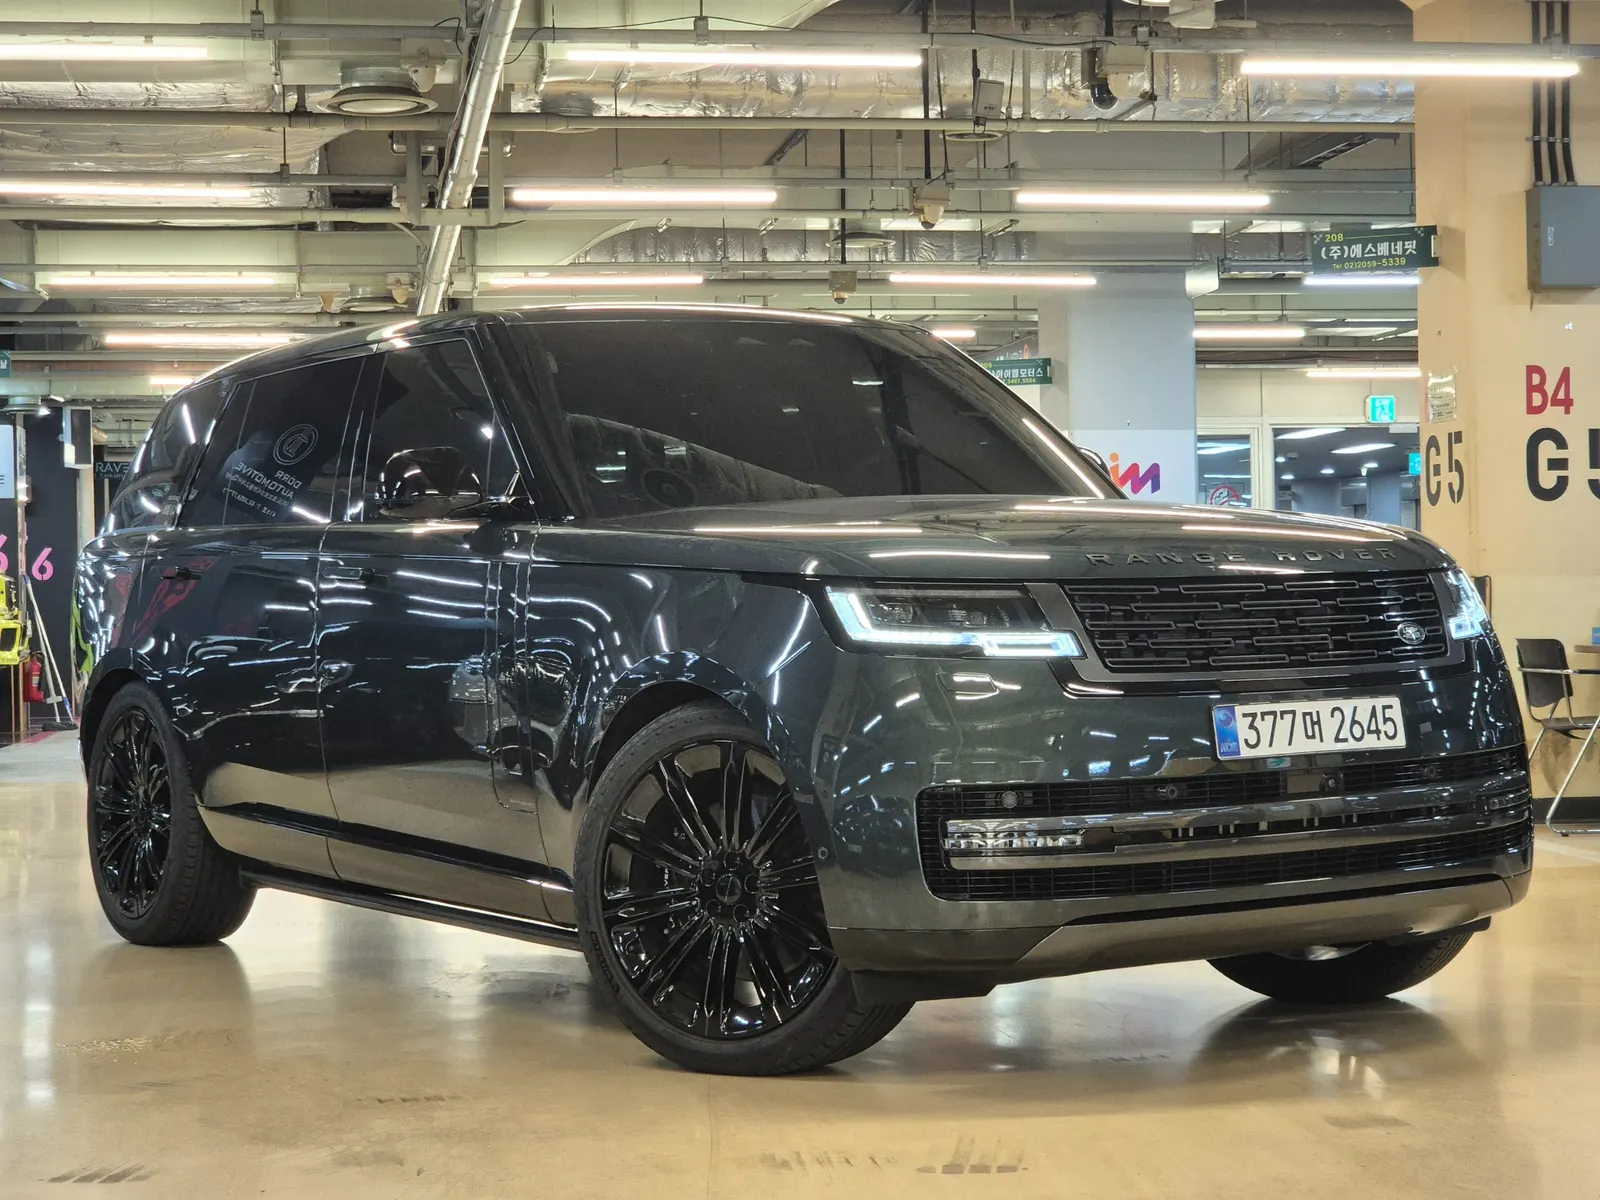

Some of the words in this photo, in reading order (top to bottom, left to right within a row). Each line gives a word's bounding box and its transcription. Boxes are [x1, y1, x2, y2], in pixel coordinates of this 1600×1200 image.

[1325, 233, 1344, 242] 208
[1321, 240, 1417, 259] (주)에스베네핏
[1344, 257, 1406, 269] 02)2059-5339
[1526, 365, 1574, 415] B4
[1425, 430, 1464, 506] G5
[1086, 551, 1247, 566] RANGE
[1272, 548, 1397, 562] ROVER
[1330, 704, 1398, 744] 2645
